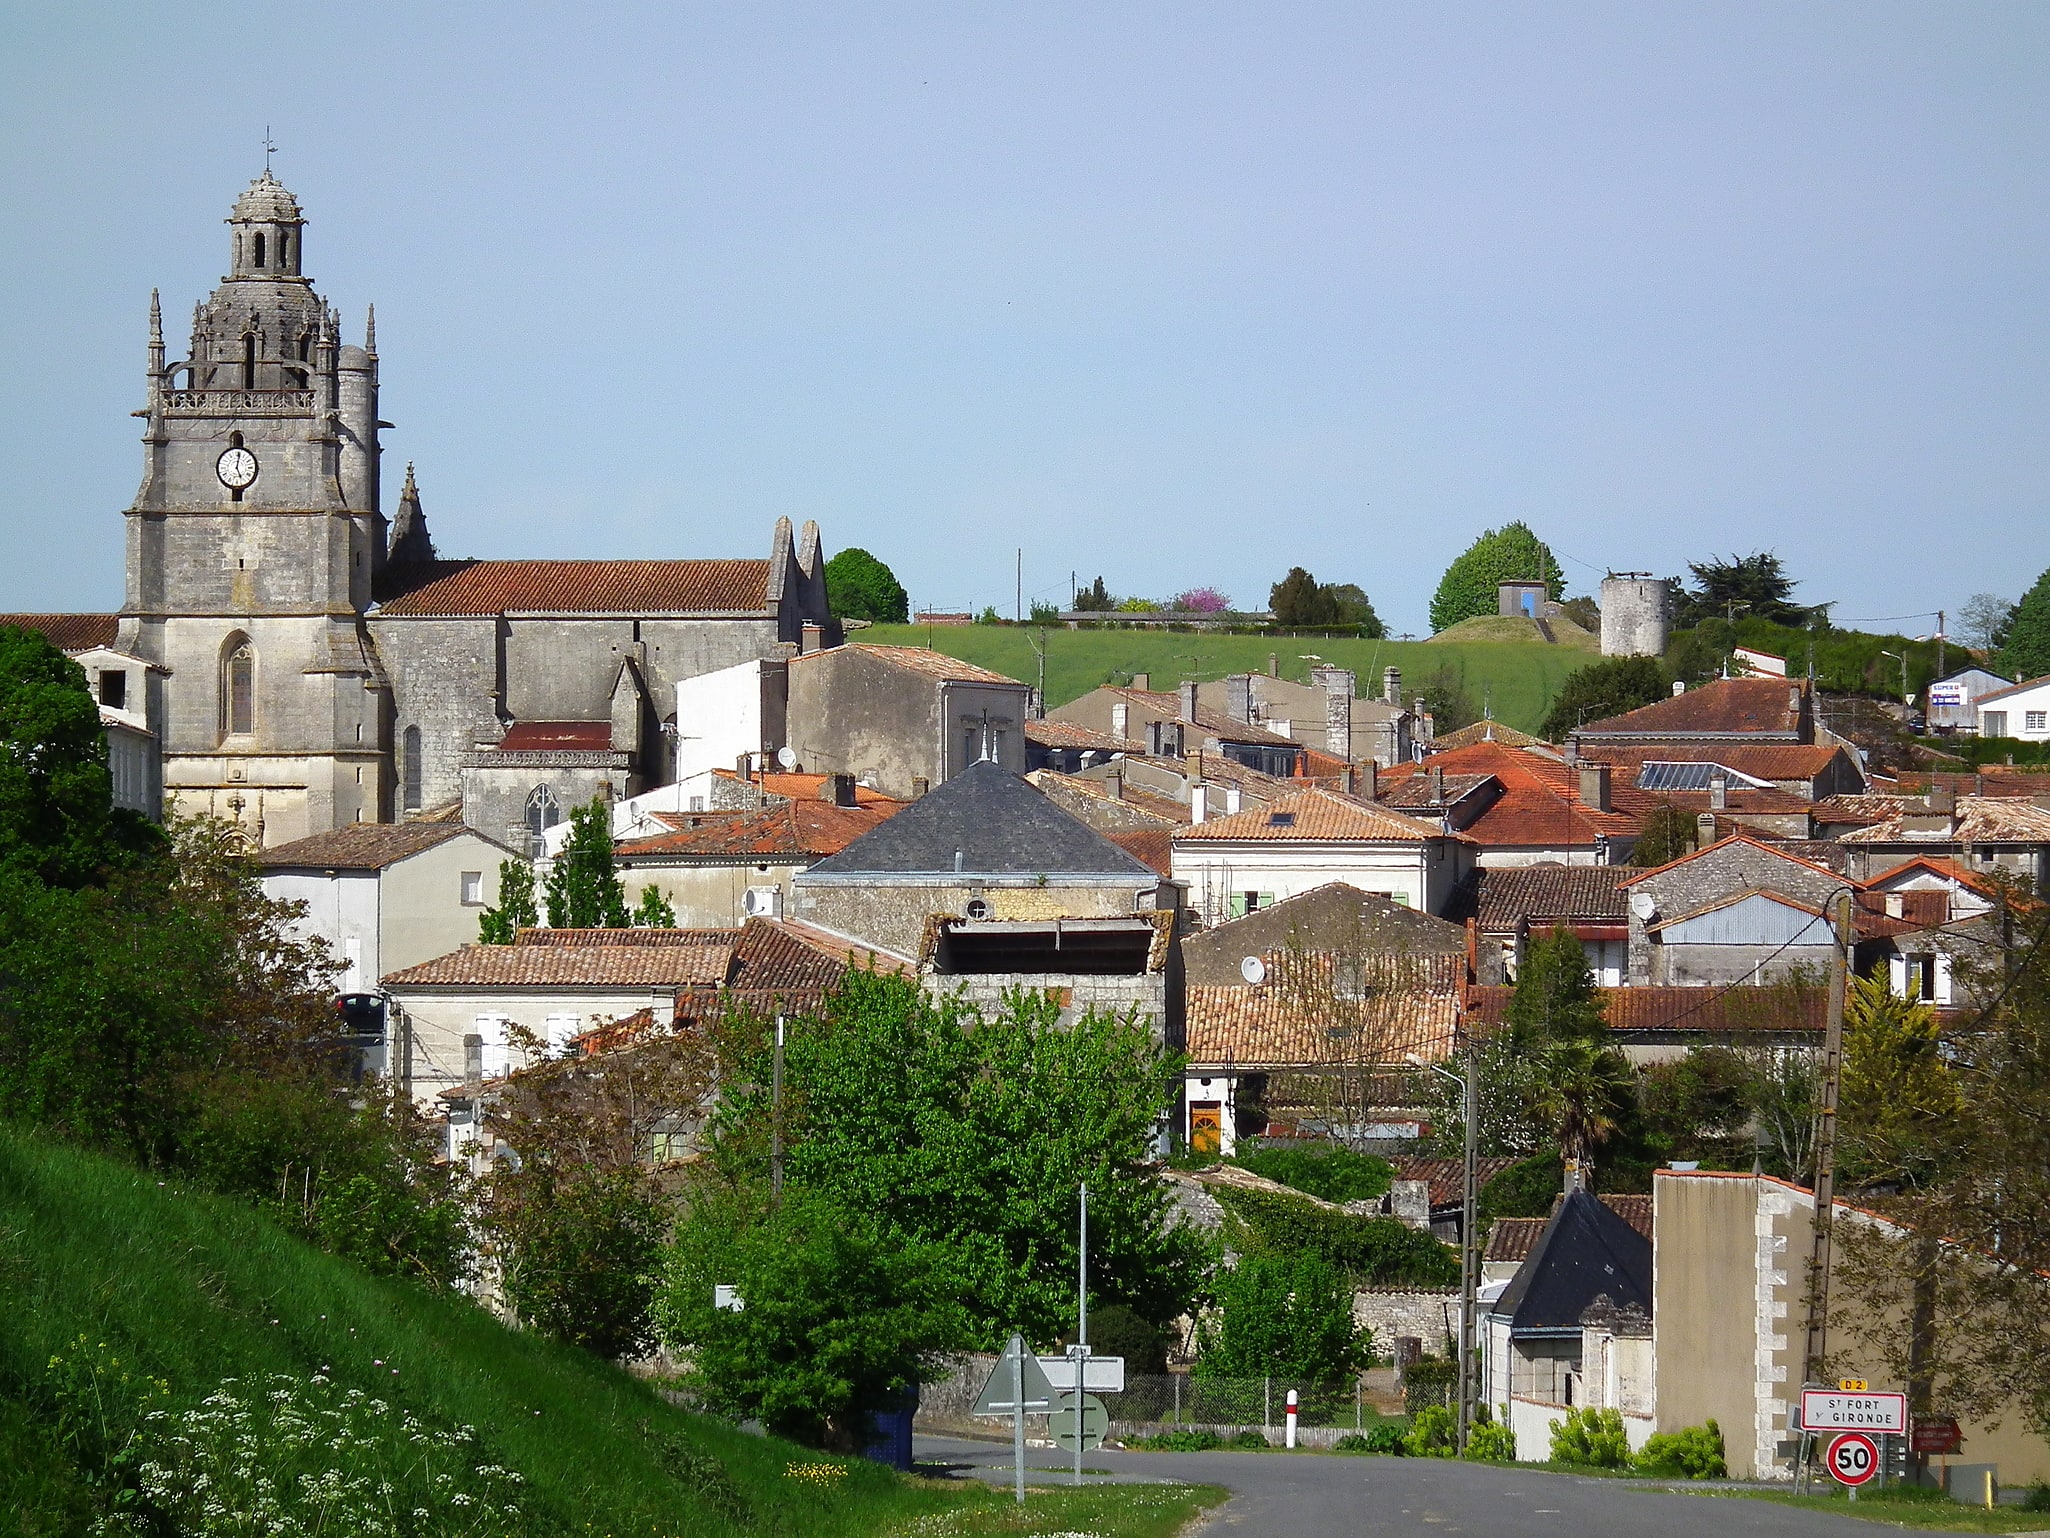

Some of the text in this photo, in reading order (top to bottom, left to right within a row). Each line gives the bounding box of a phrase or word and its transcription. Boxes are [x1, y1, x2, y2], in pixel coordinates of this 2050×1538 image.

[1845, 1380, 1862, 1390] D 2
[1847, 1400, 1879, 1409] FORT
[1833, 1413, 1892, 1423] GIRONDE
[1838, 1448, 1869, 1469] 50
